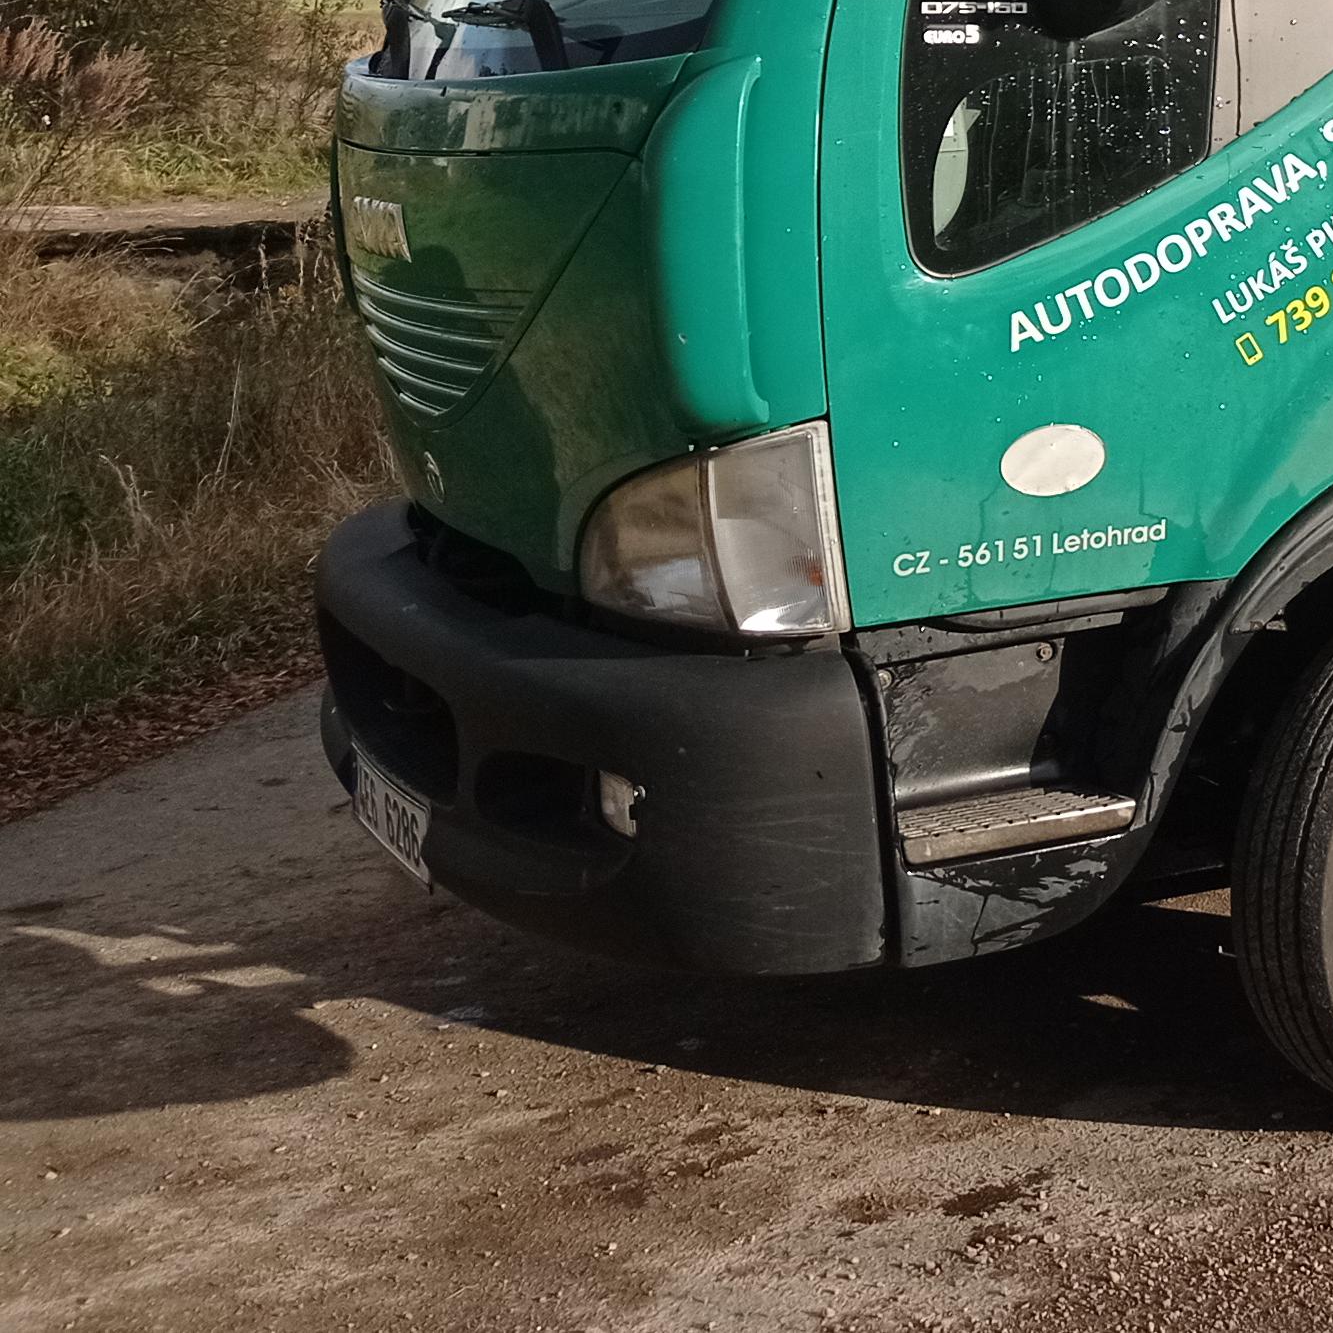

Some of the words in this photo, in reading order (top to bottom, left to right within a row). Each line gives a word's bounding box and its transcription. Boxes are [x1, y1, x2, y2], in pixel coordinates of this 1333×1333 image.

[1009, 152, 1328, 352] AUTODOPRAVA,
[1211, 238, 1309, 324] LUKÁŠ
[1265, 286, 1331, 345] 739
[893, 551, 931, 577] CZ
[957, 540, 1005, 567] 561
[1012, 535, 1042, 560] 51
[1052, 518, 1167, 554] Letohrad
[384, 791, 421, 868] 6286
